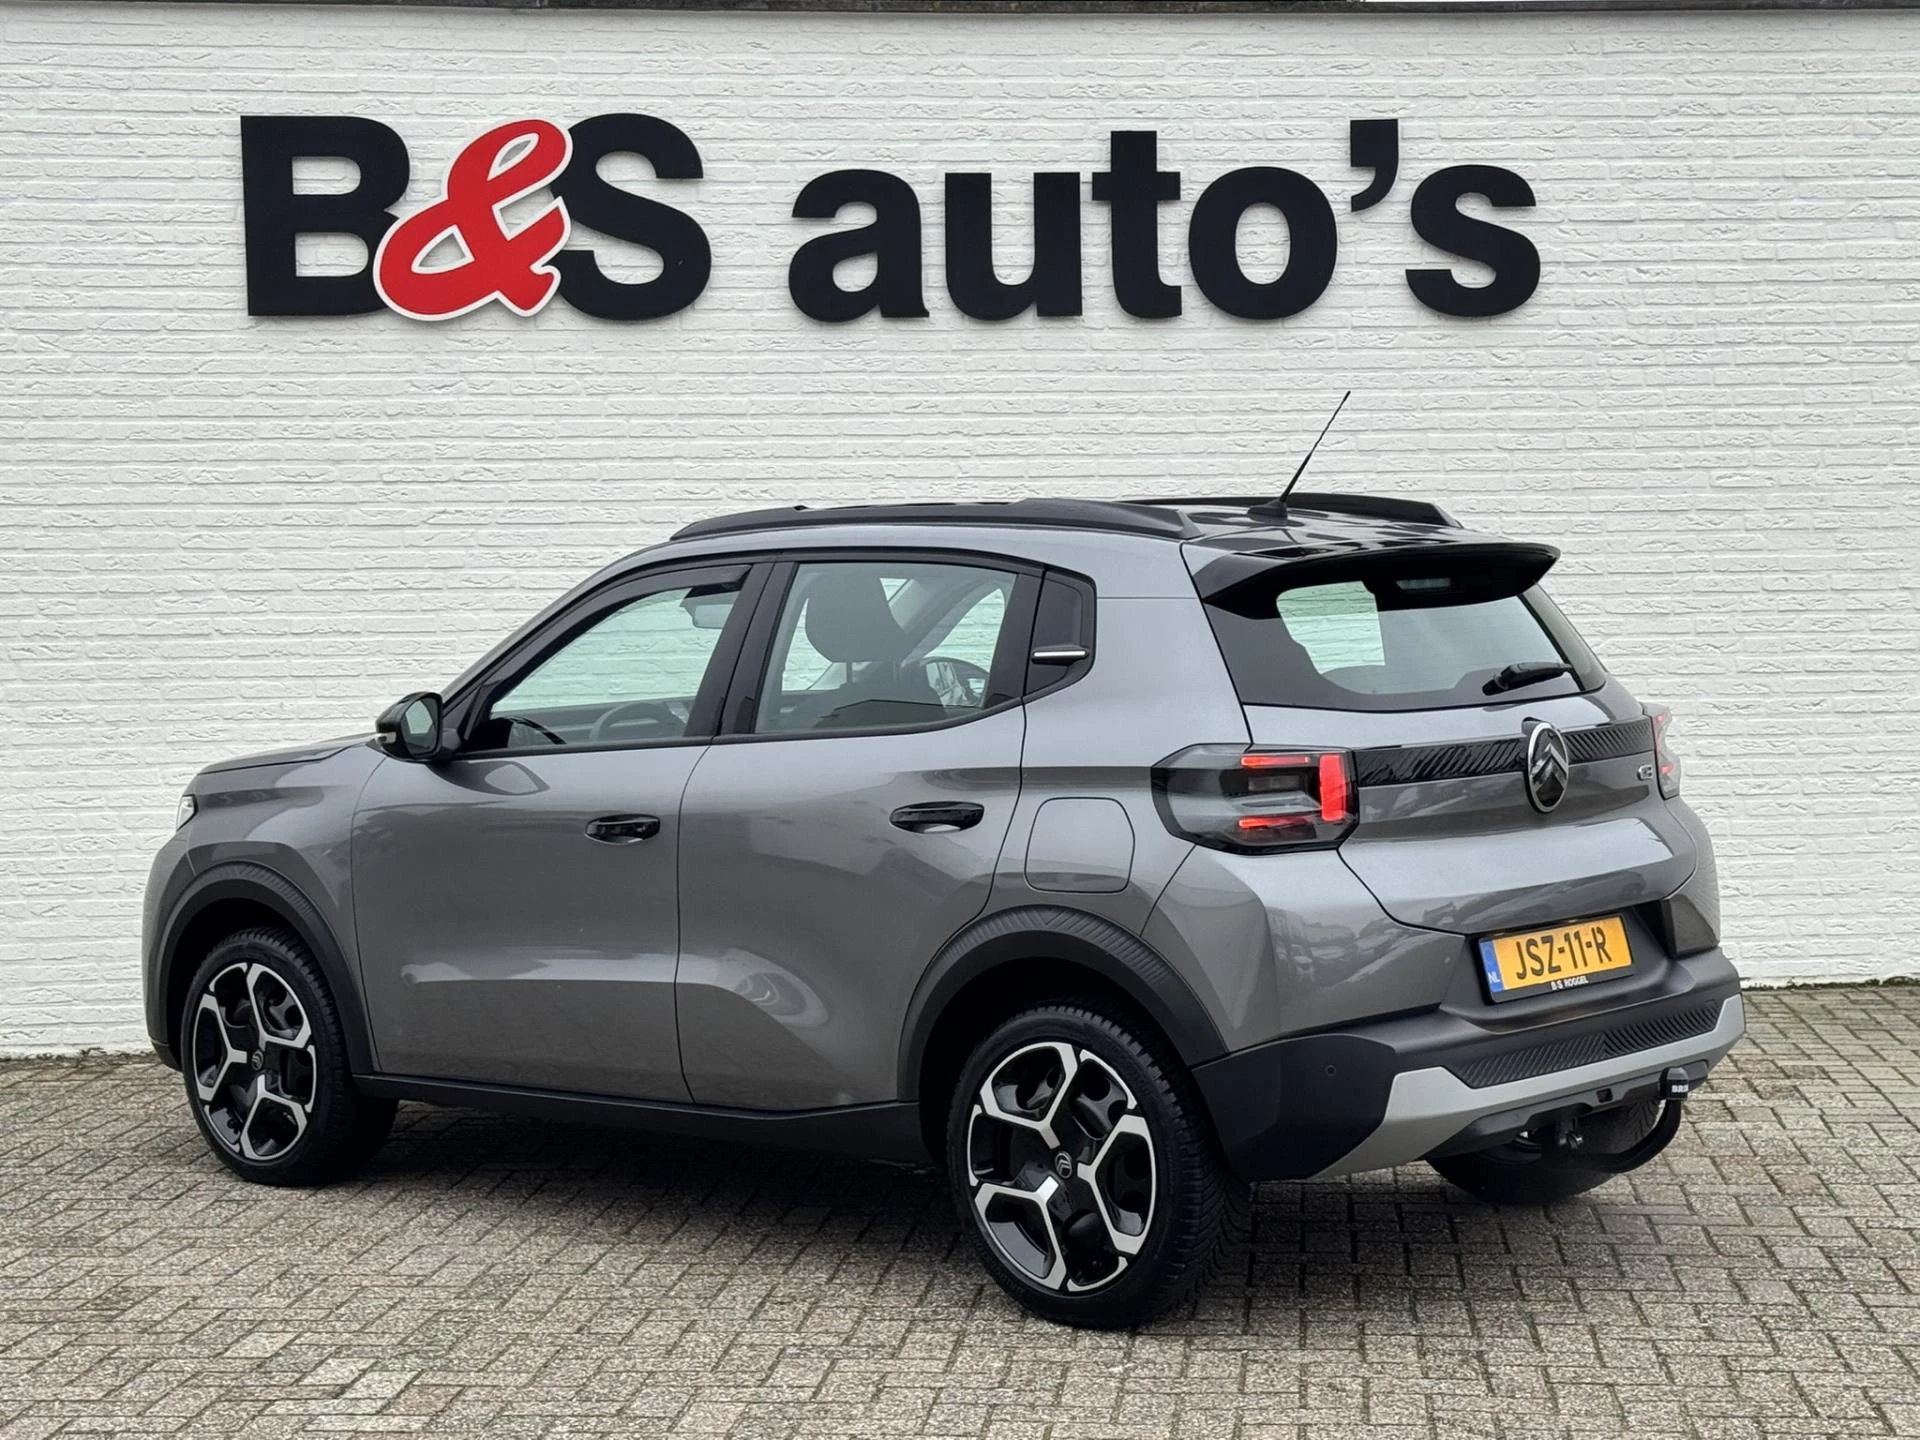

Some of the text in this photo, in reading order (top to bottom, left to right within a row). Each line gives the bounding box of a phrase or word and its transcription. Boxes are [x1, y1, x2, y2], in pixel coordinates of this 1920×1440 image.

[240, 114, 1541, 323] B&S auto's
[1488, 926, 1613, 984] NL JSZ-11-R
